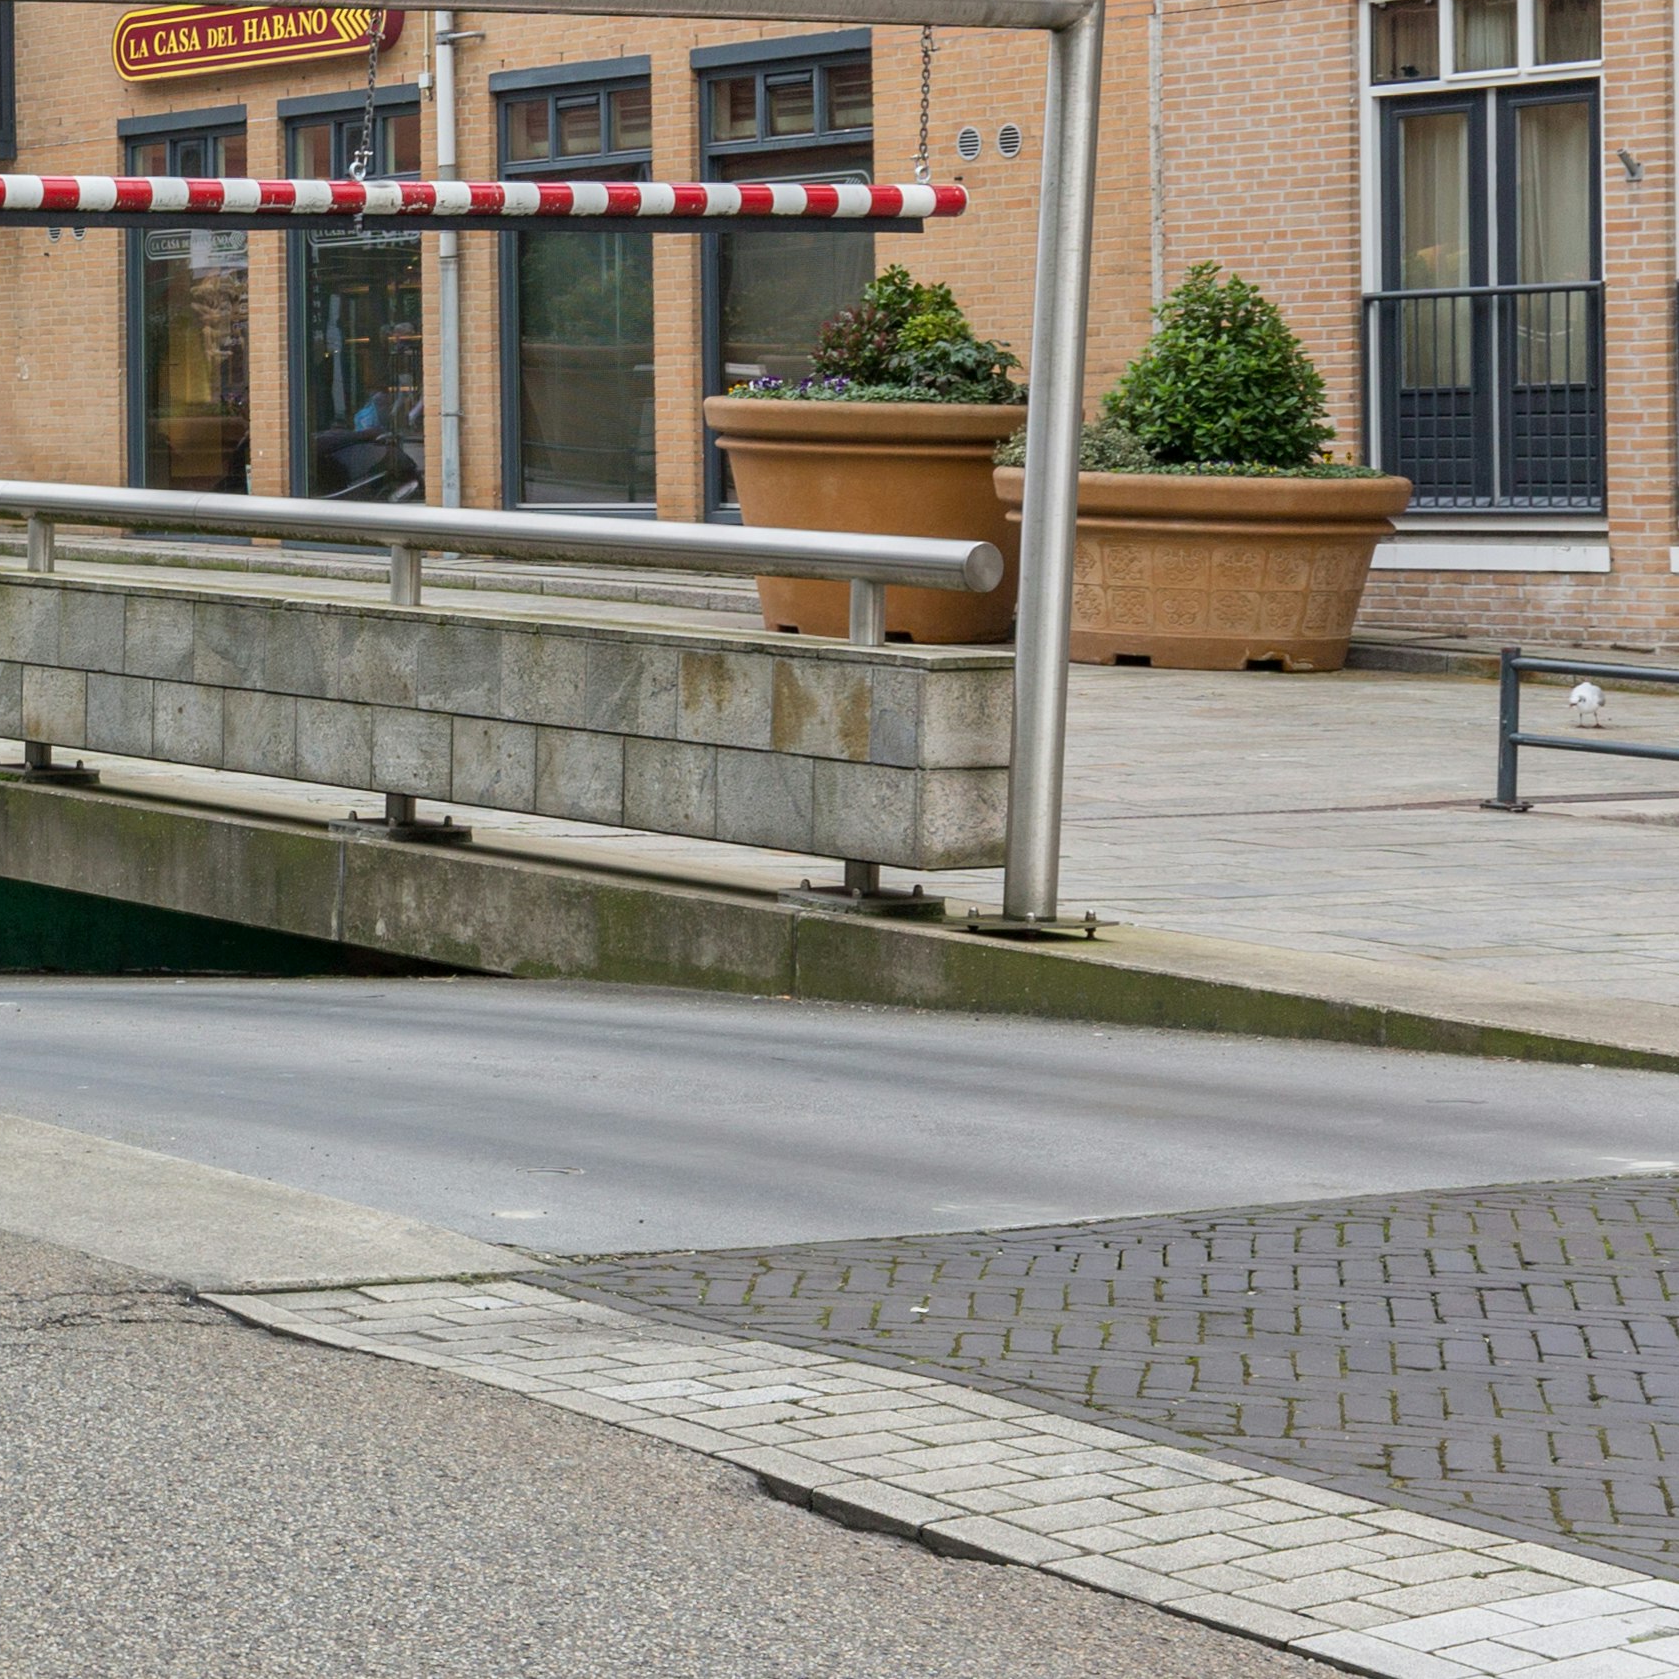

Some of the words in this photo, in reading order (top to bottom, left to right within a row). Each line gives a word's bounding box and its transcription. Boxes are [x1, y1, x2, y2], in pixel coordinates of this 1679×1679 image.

[129, 38, 149, 60] LA
[153, 26, 201, 56] CASA
[207, 25, 237, 50] DEL
[243, 8, 328, 44] HABANO
